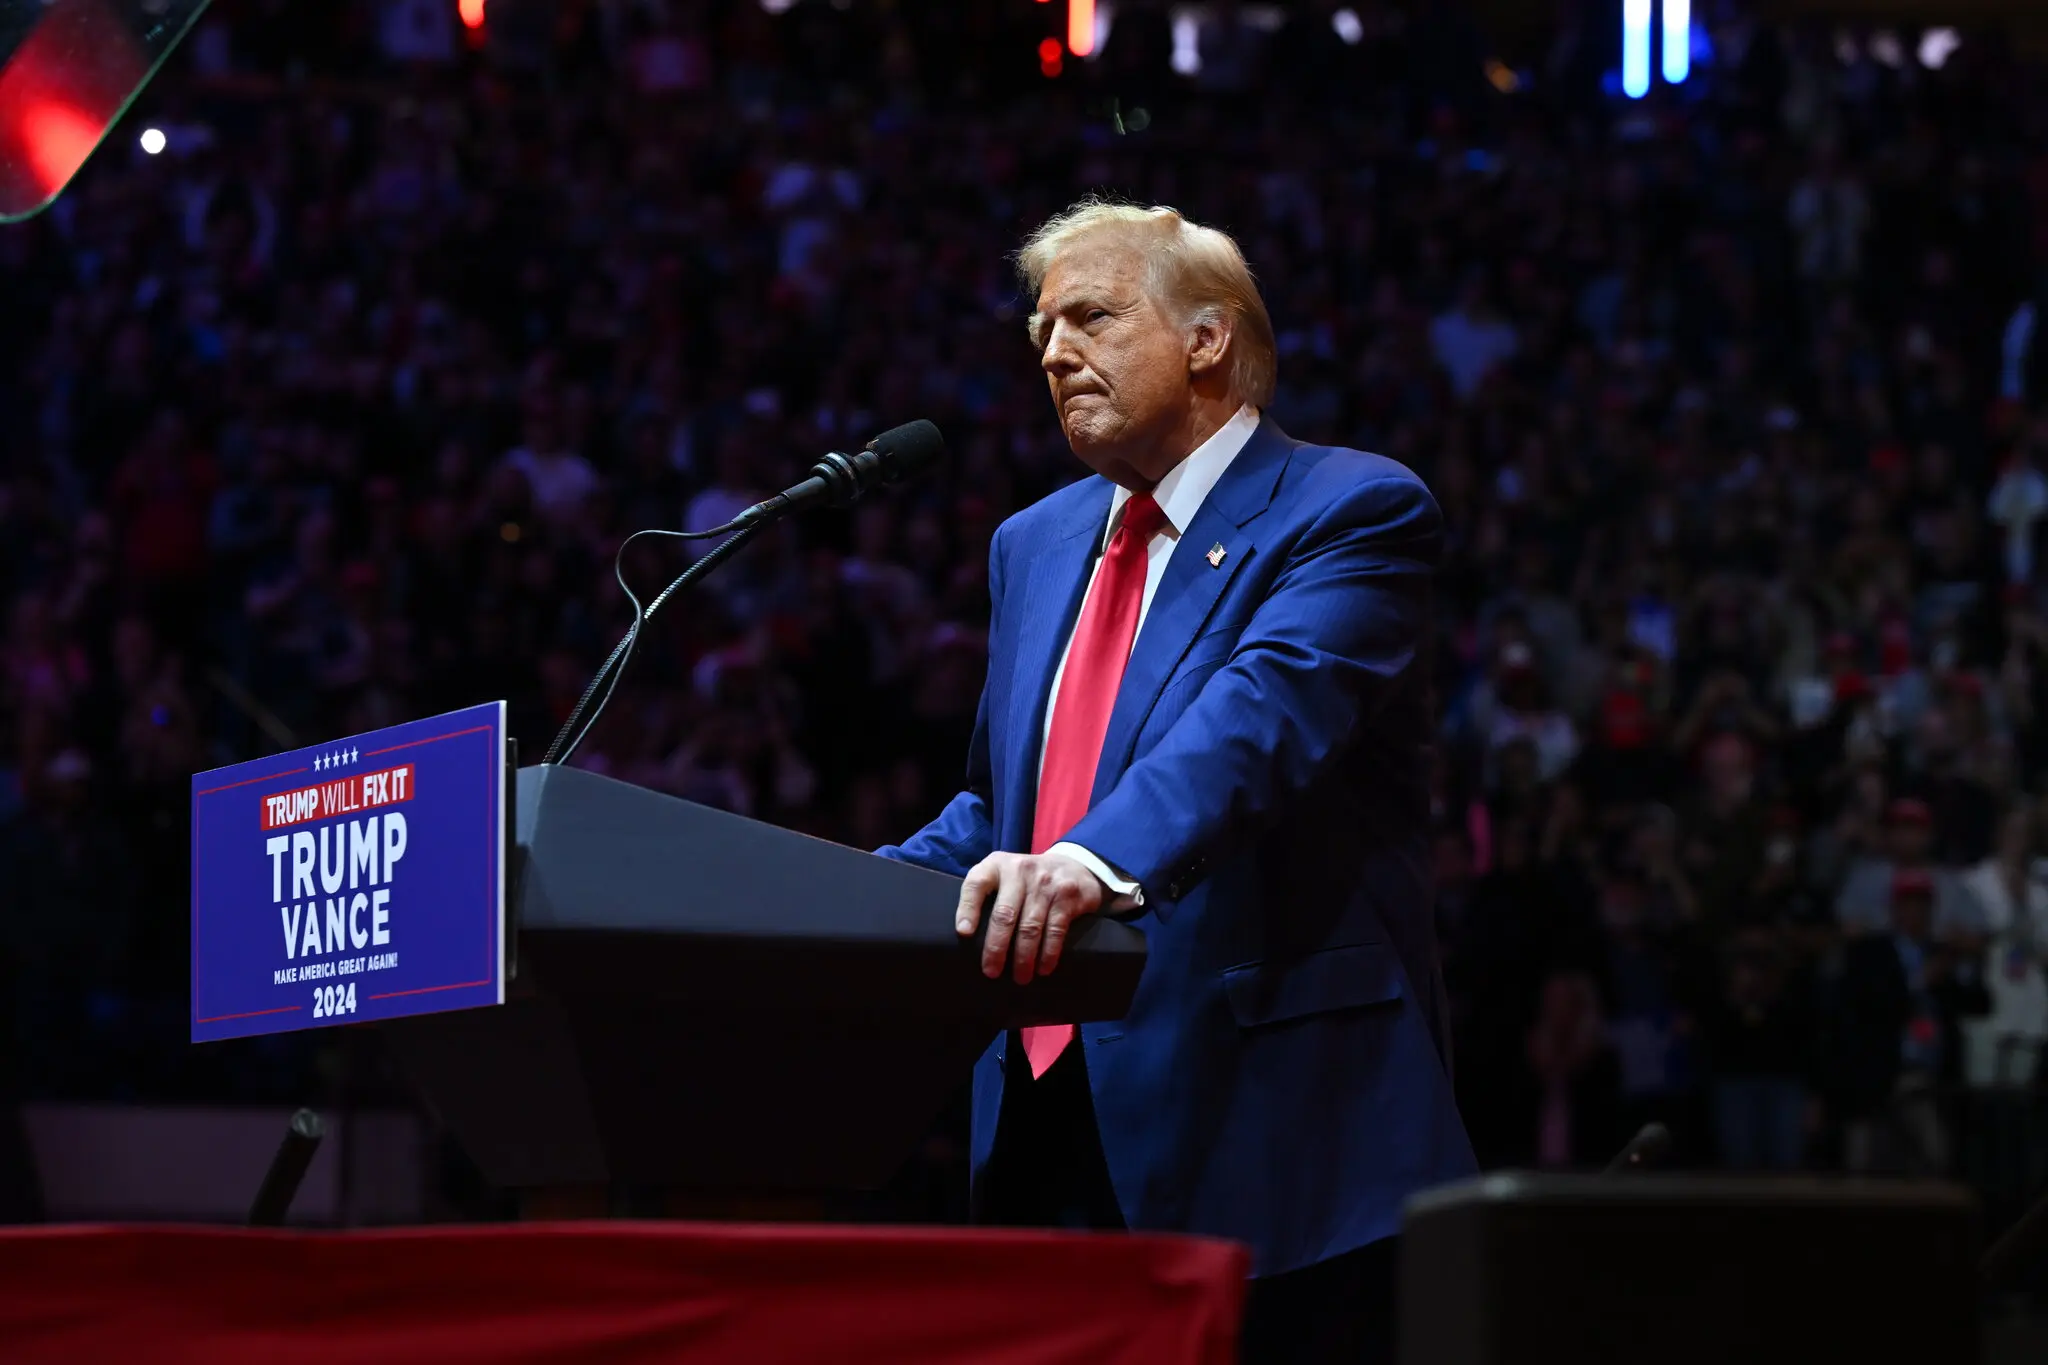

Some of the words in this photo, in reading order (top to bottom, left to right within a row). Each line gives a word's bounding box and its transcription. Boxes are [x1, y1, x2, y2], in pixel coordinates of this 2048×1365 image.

[267, 788, 319, 826] TRUMP
[322, 779, 359, 815] WILL
[363, 772, 390, 808] FIX
[392, 768, 408, 800] IT
[266, 812, 408, 903] TRUMP
[281, 889, 390, 960] VANCE
[274, 969, 296, 985] MAKE
[299, 961, 336, 981] AMERICA
[338, 958, 365, 977] GREAT
[367, 952, 398, 971] AGAIN!
[313, 983, 356, 1018] 2024
